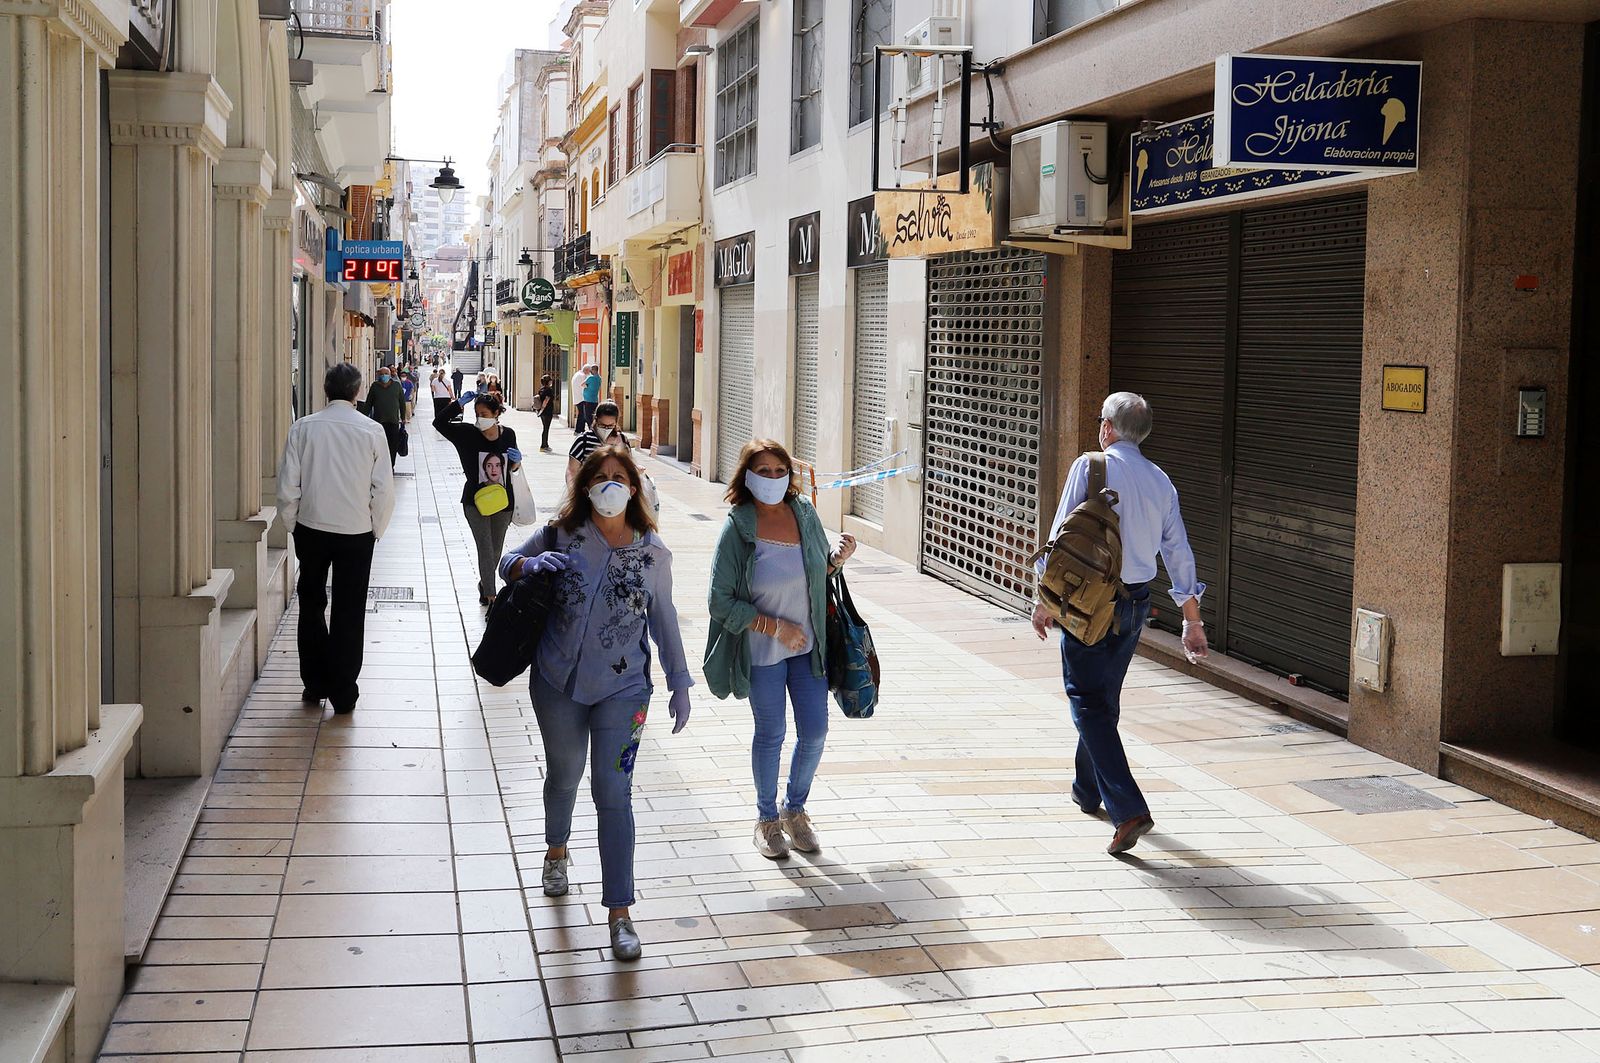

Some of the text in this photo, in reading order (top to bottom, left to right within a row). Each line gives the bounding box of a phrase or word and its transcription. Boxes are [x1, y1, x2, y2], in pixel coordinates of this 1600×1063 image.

[1232, 69, 1393, 107] Heladería
[1165, 134, 1214, 168] Hela
[1245, 115, 1351, 157] Jijona
[1323, 146, 1415, 163] Elaboracion propia
[1170, 173, 1183, 184] desde
[892, 188, 954, 248] salvia
[344, 245, 400, 256] optica urbano
[718, 241, 752, 279] MAGIC
[798, 224, 813, 265] M
[1386, 383, 1422, 394] ABOGADOS
